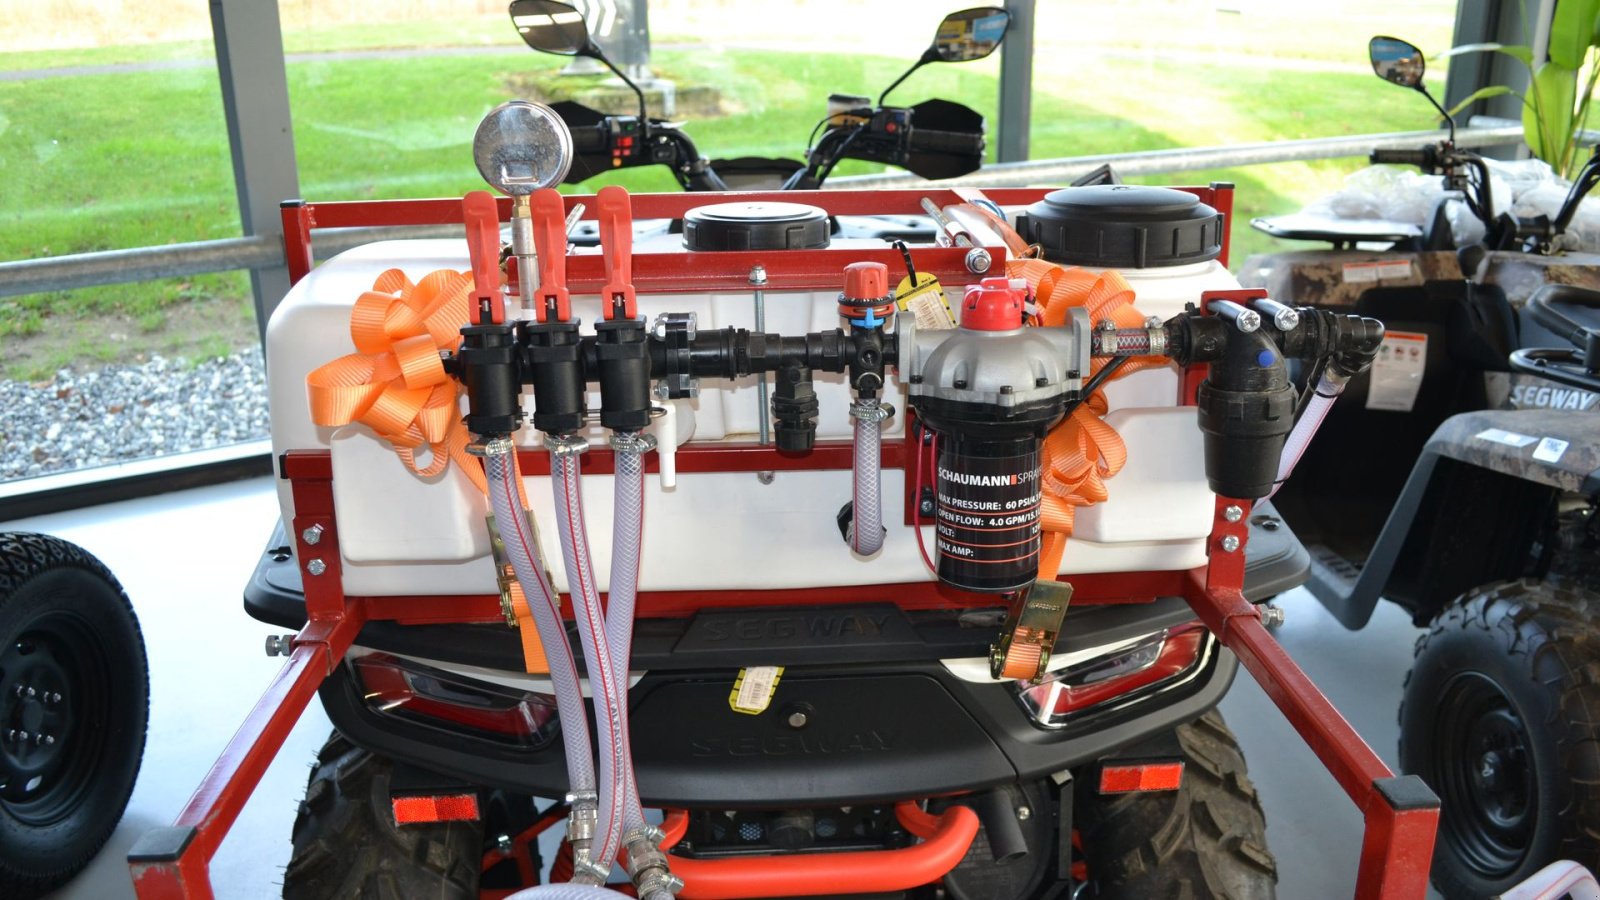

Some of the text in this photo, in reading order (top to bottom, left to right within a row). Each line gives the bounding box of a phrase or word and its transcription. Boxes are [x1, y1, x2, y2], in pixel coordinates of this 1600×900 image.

[1510, 385, 1595, 411] SEGWAY
[938, 466, 1010, 487] SCHAUMANN
[938, 492, 951, 505] MAX
[952, 499, 1002, 510] PRESSURE:
[1005, 501, 1017, 510] 60
[938, 508, 954, 522] OPEN
[955, 515, 985, 526] FLOW:
[989, 518, 1004, 526] 4.0
[938, 524, 955, 538] VOLT:
[938, 539, 974, 557] MAX AMP:
[703, 613, 892, 641] SEGWAY
[690, 729, 896, 758] SEGWAY
